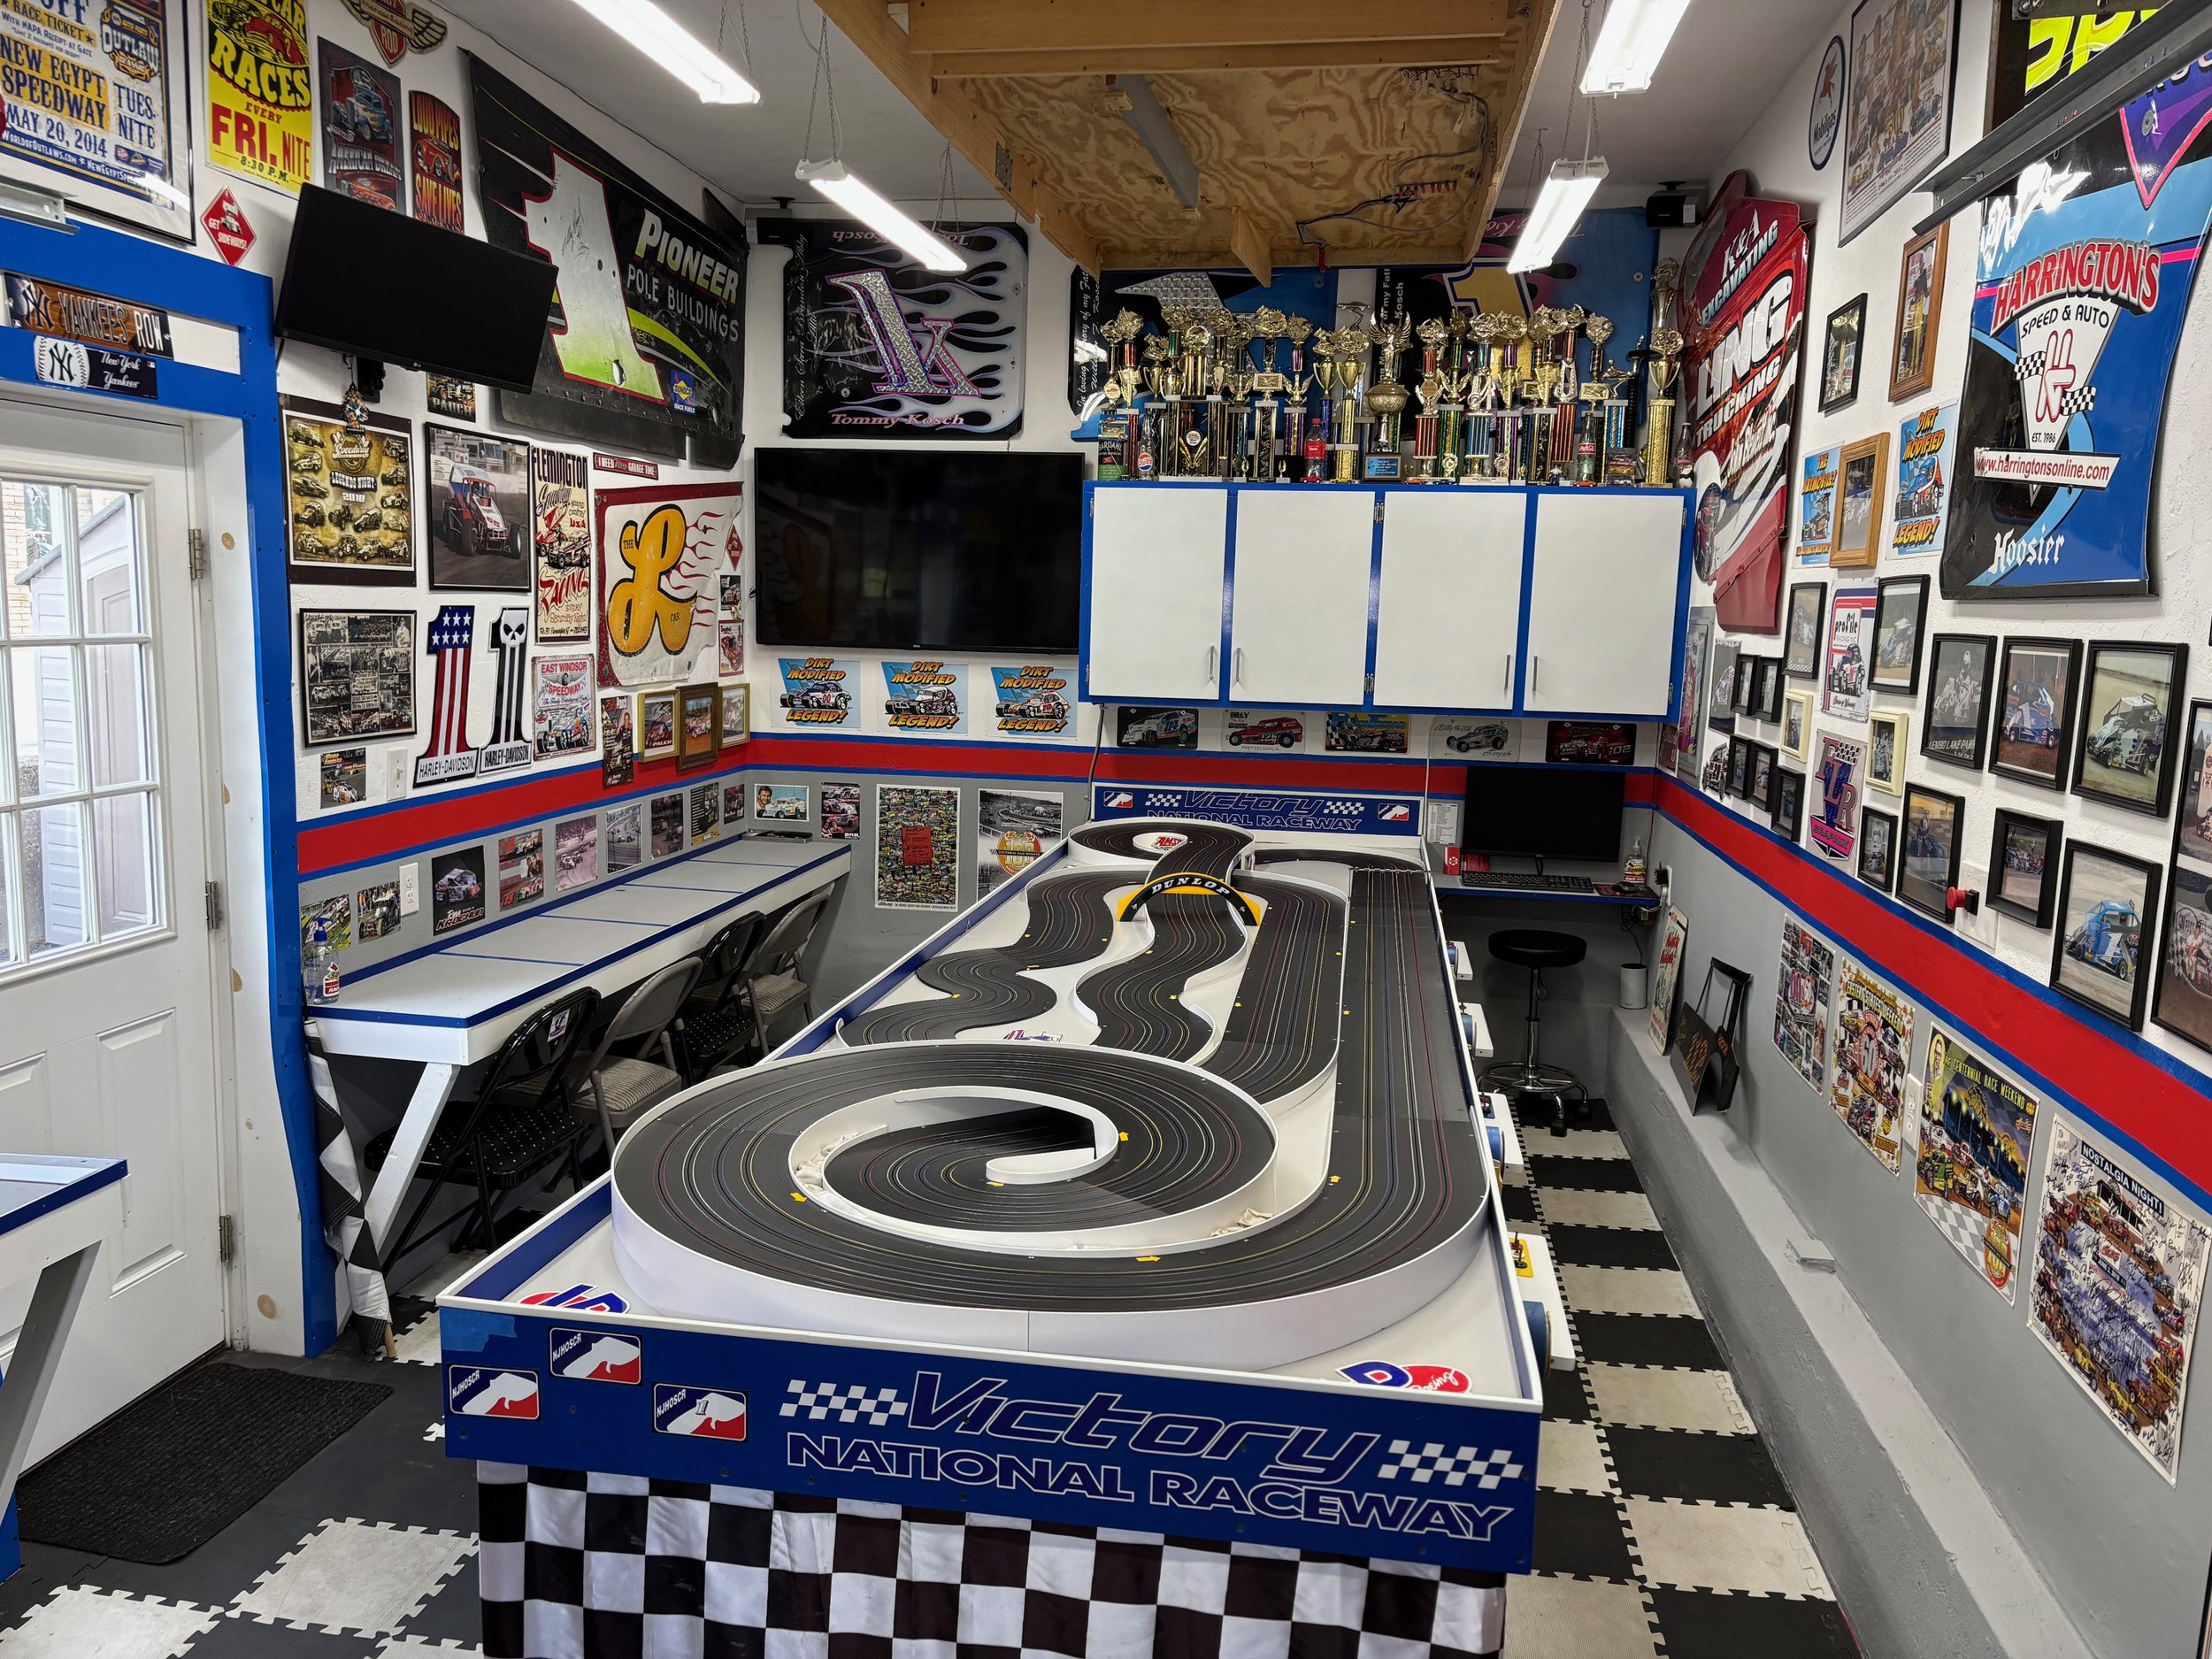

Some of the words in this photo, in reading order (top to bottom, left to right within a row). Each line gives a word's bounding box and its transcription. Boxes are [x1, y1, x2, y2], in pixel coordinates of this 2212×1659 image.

[13, 1, 42, 22] RACE
[45, 12, 84, 41] TICKET
[22, 20, 42, 35] NAPA
[102, 24, 159, 73] OUTLAW
[381, 27, 397, 55] ROD
[0, 35, 42, 73] NEW
[49, 54, 105, 98] EGYPT
[211, 29, 311, 107] RACES
[2, 64, 107, 129] SPEEDWAY
[245, 102, 283, 124] EVERY
[411, 95, 435, 139] LOUD
[6, 103, 39, 134] MAY
[46, 118, 70, 147] 20,
[75, 128, 108, 157] 2014
[118, 113, 156, 150] NITE
[212, 103, 278, 166] FRI.
[283, 130, 311, 180] NITE
[240, 157, 265, 173] 8:30
[267, 166, 289, 183] P.M.
[329, 142, 374, 174] AMERICAN
[415, 173, 437, 211] SAVE
[208, 218, 220, 230] GET
[218, 232, 248, 250] SIDEWAYS!
[1721, 209, 1761, 283] K&A
[634, 209, 739, 304] PIONEER
[1701, 219, 1778, 326] EXCAVATING
[1383, 291, 1390, 307] my
[1993, 244, 2161, 331] HARRINGTON'S
[626, 264, 659, 303] POLE
[668, 285, 739, 342] BUILDINGS
[1394, 282, 1404, 319] Kosch
[58, 291, 129, 346] YANKEES
[134, 311, 165, 352] ROW
[2021, 311, 2058, 339] SPEED
[2062, 306, 2072, 322] &
[2076, 305, 2110, 330] AUTO
[49, 342, 74, 382] NY
[101, 351, 119, 366] New
[119, 353, 141, 371] York
[103, 370, 140, 389] Yankees
[673, 385, 693, 397] SUNOCO
[1079, 365, 1090, 395] loving
[432, 397, 474, 418] PAUCH
[674, 402, 684, 412] RACE
[684, 404, 695, 414] FUELS
[1696, 356, 1781, 447] TRUCKING
[832, 413, 900, 429] Tommy
[905, 413, 965, 426] Kosch
[1916, 406, 1939, 434] DIRT
[1099, 442, 1123, 451] BARDAHL
[1902, 430, 1946, 464] MODIFIED
[2032, 432, 2043, 442] EST.
[2044, 432, 2056, 443] 1986
[531, 446, 588, 489] FLEMINGTON
[602, 457, 614, 468] NEED
[628, 461, 644, 474] GARAGE
[644, 465, 655, 476] TIME
[1817, 452, 1829, 471] THE
[1975, 456, 2110, 480] www.harringtonsonline.com
[332, 471, 357, 489] LEGENDS
[357, 477, 375, 489] NIGHT
[342, 492, 365, 503] 2010
[570, 518, 587, 528] USA
[1893, 516, 1940, 548] LEGEND!
[623, 540, 634, 549] THE
[1988, 524, 2065, 577] Hoosier
[670, 612, 680, 623] CAR
[1834, 613, 1858, 641] profile
[541, 664, 557, 673] EAST
[559, 661, 587, 672] WINDSOR
[787, 669, 847, 681] MODIFIED
[805, 658, 833, 670] DIRT
[911, 661, 943, 673] DIRT
[1019, 665, 1053, 678] DIRT
[549, 684, 581, 696] SPEEDWAY
[891, 672, 957, 685] MODIFIED
[999, 677, 1068, 690] MODIFIED
[785, 709, 848, 724] LEGEND!
[889, 714, 959, 729] LEGEND!
[998, 718, 1068, 733] LEGEND!
[652, 739, 672, 749] PAUCH
[1947, 739, 1960, 749] LAKE
[419, 757, 474, 780] HARLEY-DAVIDSON
[485, 745, 529, 769] HARLEY-DAVIDSON
[1184, 790, 1326, 818] Victory
[1147, 810, 1253, 826] NATIONAL
[1256, 816, 1363, 831] RACEWAY
[1151, 877, 1231, 895] DUNLOP
[1847, 981, 1864, 1000] EASTERN
[1864, 990, 1881, 1011] STATES
[1862, 1033, 1876, 1079] 60
[1954, 1058, 1982, 1085] CENTENNIAL
[1984, 1074, 1999, 1092] RACE
[2001, 1083, 2025, 1110] WEEKEND
[2083, 1144, 2130, 1191] NOSTALGIA
[2131, 1180, 2163, 1215] NIGHT!
[908, 1371, 1381, 1485] Victory
[787, 1432, 1134, 1503] NATIONAL
[1149, 1470, 1514, 1541] RACEWAY
